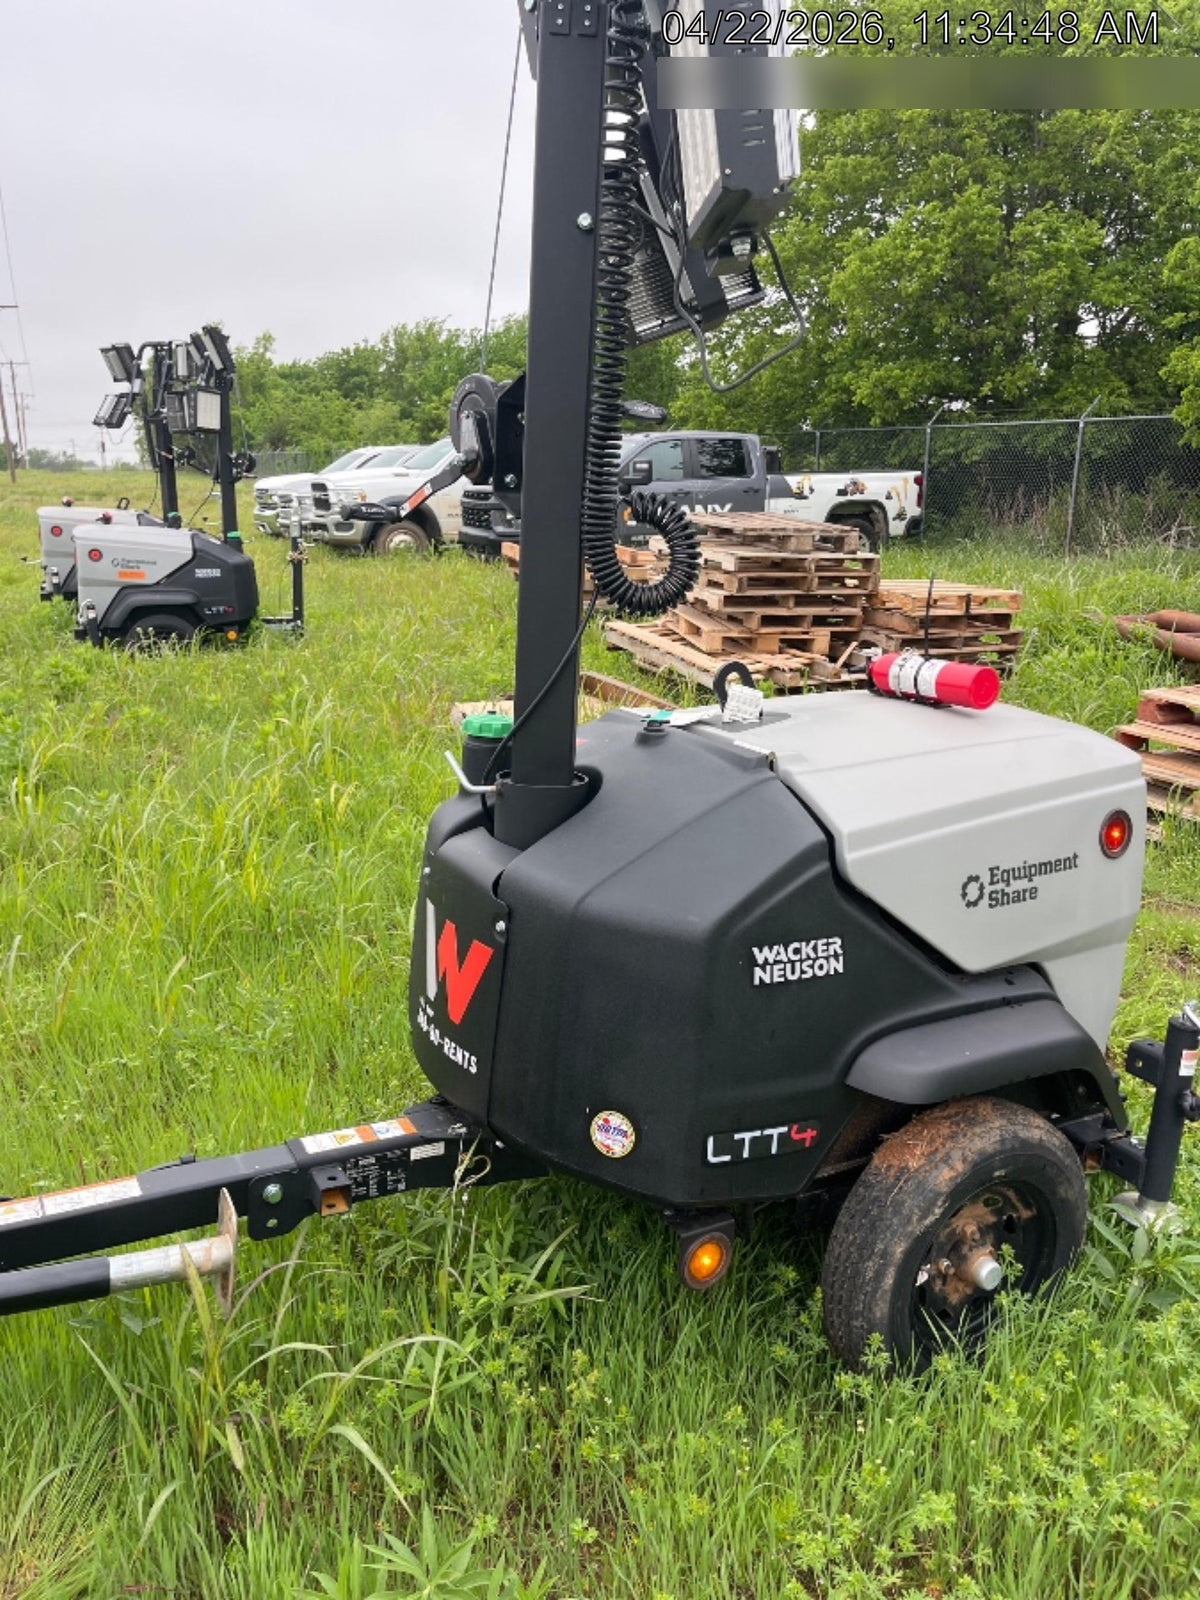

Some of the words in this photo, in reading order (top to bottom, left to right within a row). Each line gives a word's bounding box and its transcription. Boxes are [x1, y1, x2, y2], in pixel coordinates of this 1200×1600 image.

[988, 851, 1079, 887] Equipment
[988, 886, 1038, 909] Share
[752, 936, 843, 965] WACKER
[753, 954, 844, 986] NEUSON
[707, 1124, 818, 1164] LTT4
